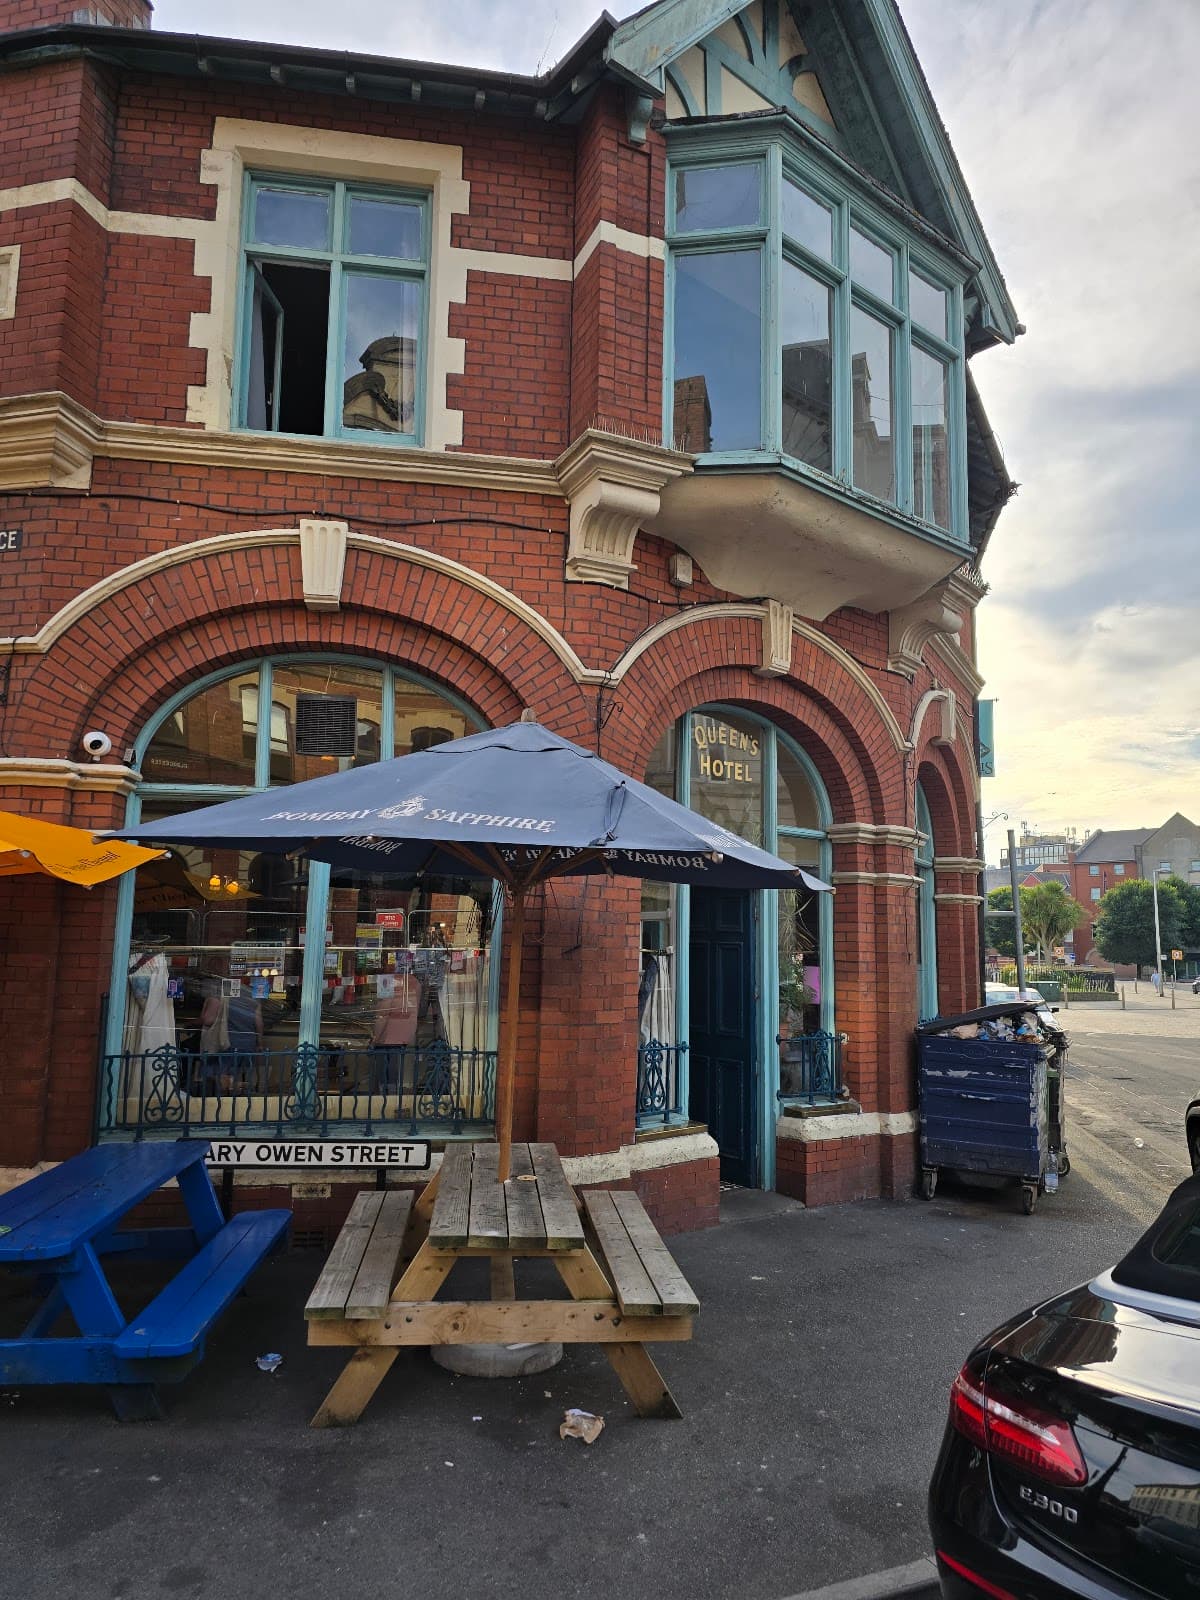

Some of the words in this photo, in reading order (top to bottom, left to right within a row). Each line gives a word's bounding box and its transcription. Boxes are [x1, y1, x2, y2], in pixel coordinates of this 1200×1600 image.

[694, 725, 759, 756] QUEEN'S
[700, 753, 753, 782] HOTEL
[259, 808, 378, 822] BOMBAY
[424, 808, 556, 833] SAPPHIRE
[255, 1144, 324, 1163] OWEN
[330, 1145, 415, 1163] STREET
